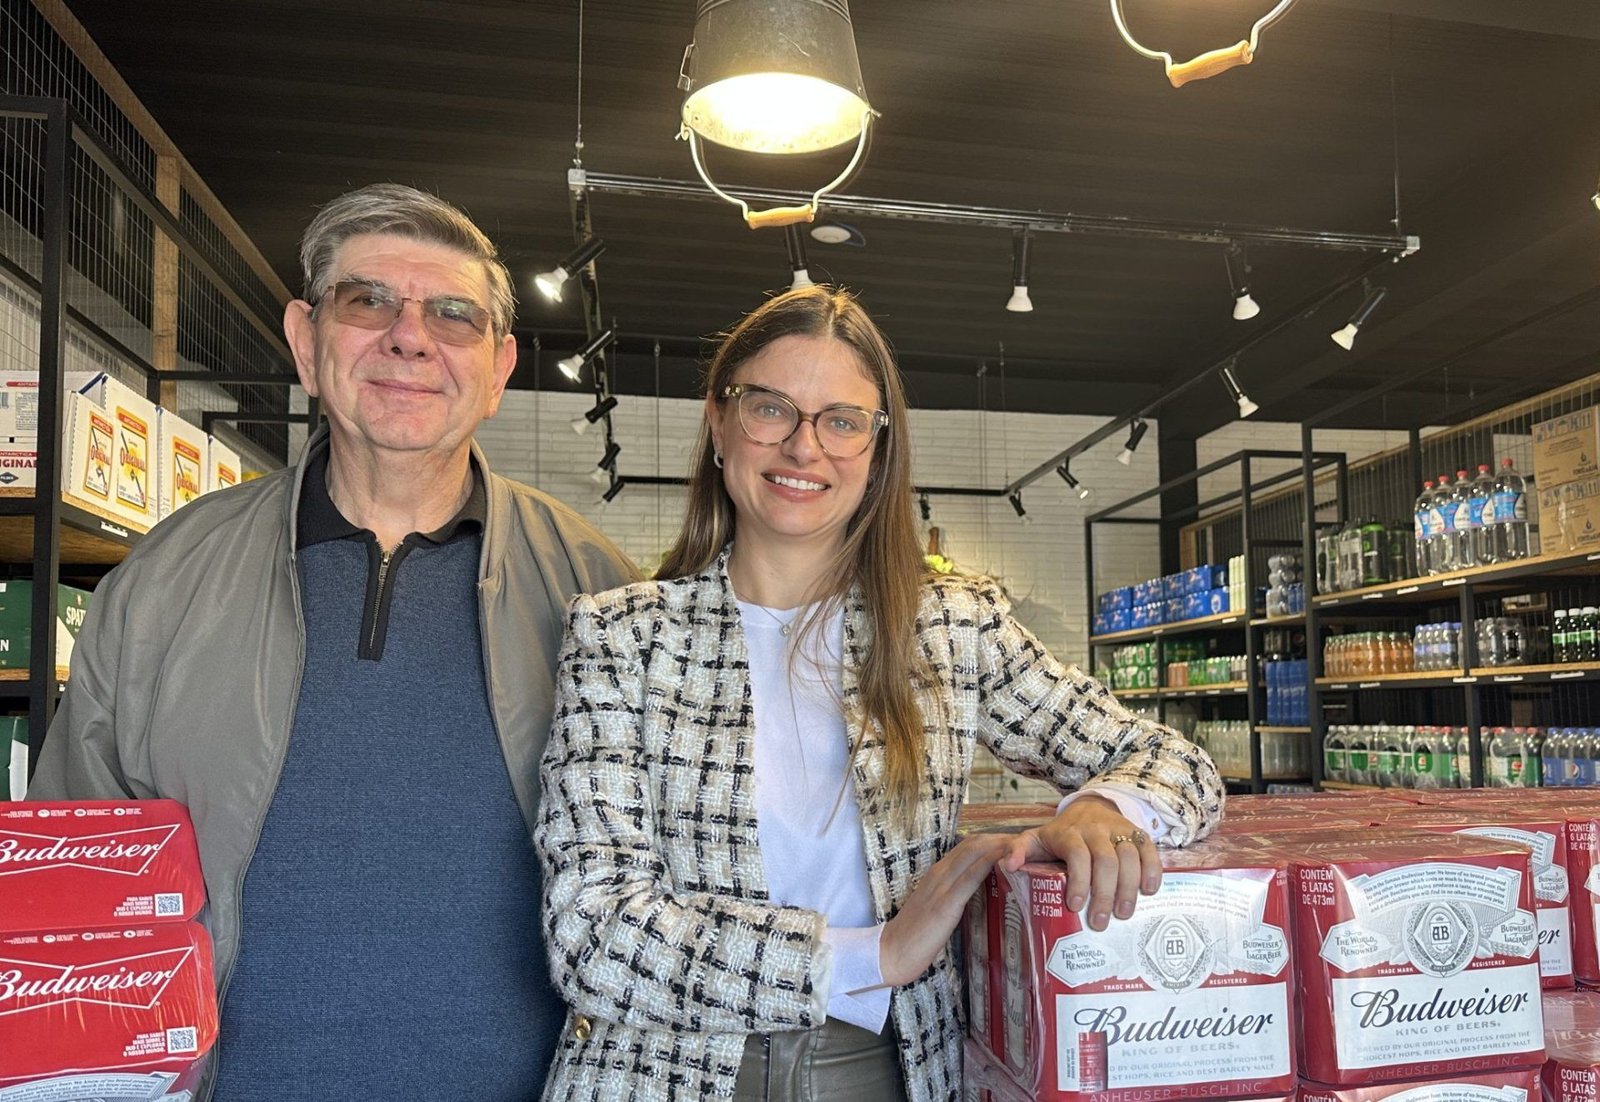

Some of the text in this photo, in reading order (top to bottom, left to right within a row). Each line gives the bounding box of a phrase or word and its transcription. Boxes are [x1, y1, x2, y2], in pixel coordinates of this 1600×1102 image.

[1568, 822, 1596, 834] CONTÉM
[1569, 832, 1598, 843] 6 LATAS
[0, 837, 159, 864] Budweiser
[1570, 843, 1580, 851] DE
[1300, 867, 1334, 881] CONTÉM
[1032, 878, 1062, 891] CONTÉM
[1301, 882, 1335, 894] 6 LATAS
[1032, 893, 1062, 904] 6 LATAS
[1302, 894, 1336, 906] DE 473ml
[1033, 905, 1063, 918] DE 473ml
[1242, 940, 1280, 950] BUDWEISER
[1471, 959, 1506, 968] REGISTERED
[1377, 967, 1395, 975] TRADE
[0, 965, 174, 1001] Budweiser
[1103, 984, 1123, 992] TRADE
[1208, 977, 1247, 986] REGISTERED
[1351, 987, 1529, 1029] Budweiser
[1074, 1005, 1273, 1048] Budweiser
[1395, 1027, 1428, 1037] KING
[1433, 1023, 1450, 1033] OF
[1404, 1041, 1421, 1049] OUR
[1422, 1037, 1458, 1047] ORIGINAL
[1459, 1034, 1494, 1043] PROCESS
[1495, 1032, 1516, 1040] FROM
[1424, 1048, 1441, 1056] RICE
[1442, 1046, 1459, 1054] AND
[1482, 1041, 1511, 1050] BARLEY
[1512, 1038, 1531, 1047] MALT
[1121, 1047, 1160, 1058] KING
[1164, 1045, 1186, 1054] OF
[1132, 1062, 1150, 1070] OUR
[1192, 1057, 1231, 1067] PROCESS
[1233, 1055, 1256, 1063] FROM
[1153, 1070, 1175, 1079] RICE
[1175, 1069, 1195, 1077] AND
[1196, 1067, 1218, 1076] BEST
[1219, 1064, 1252, 1073] BARLEY
[1254, 1063, 1275, 1071] MALT
[1560, 1067, 1596, 1084] CONTÉM
[1561, 1081, 1597, 1096] 6 LATAS
